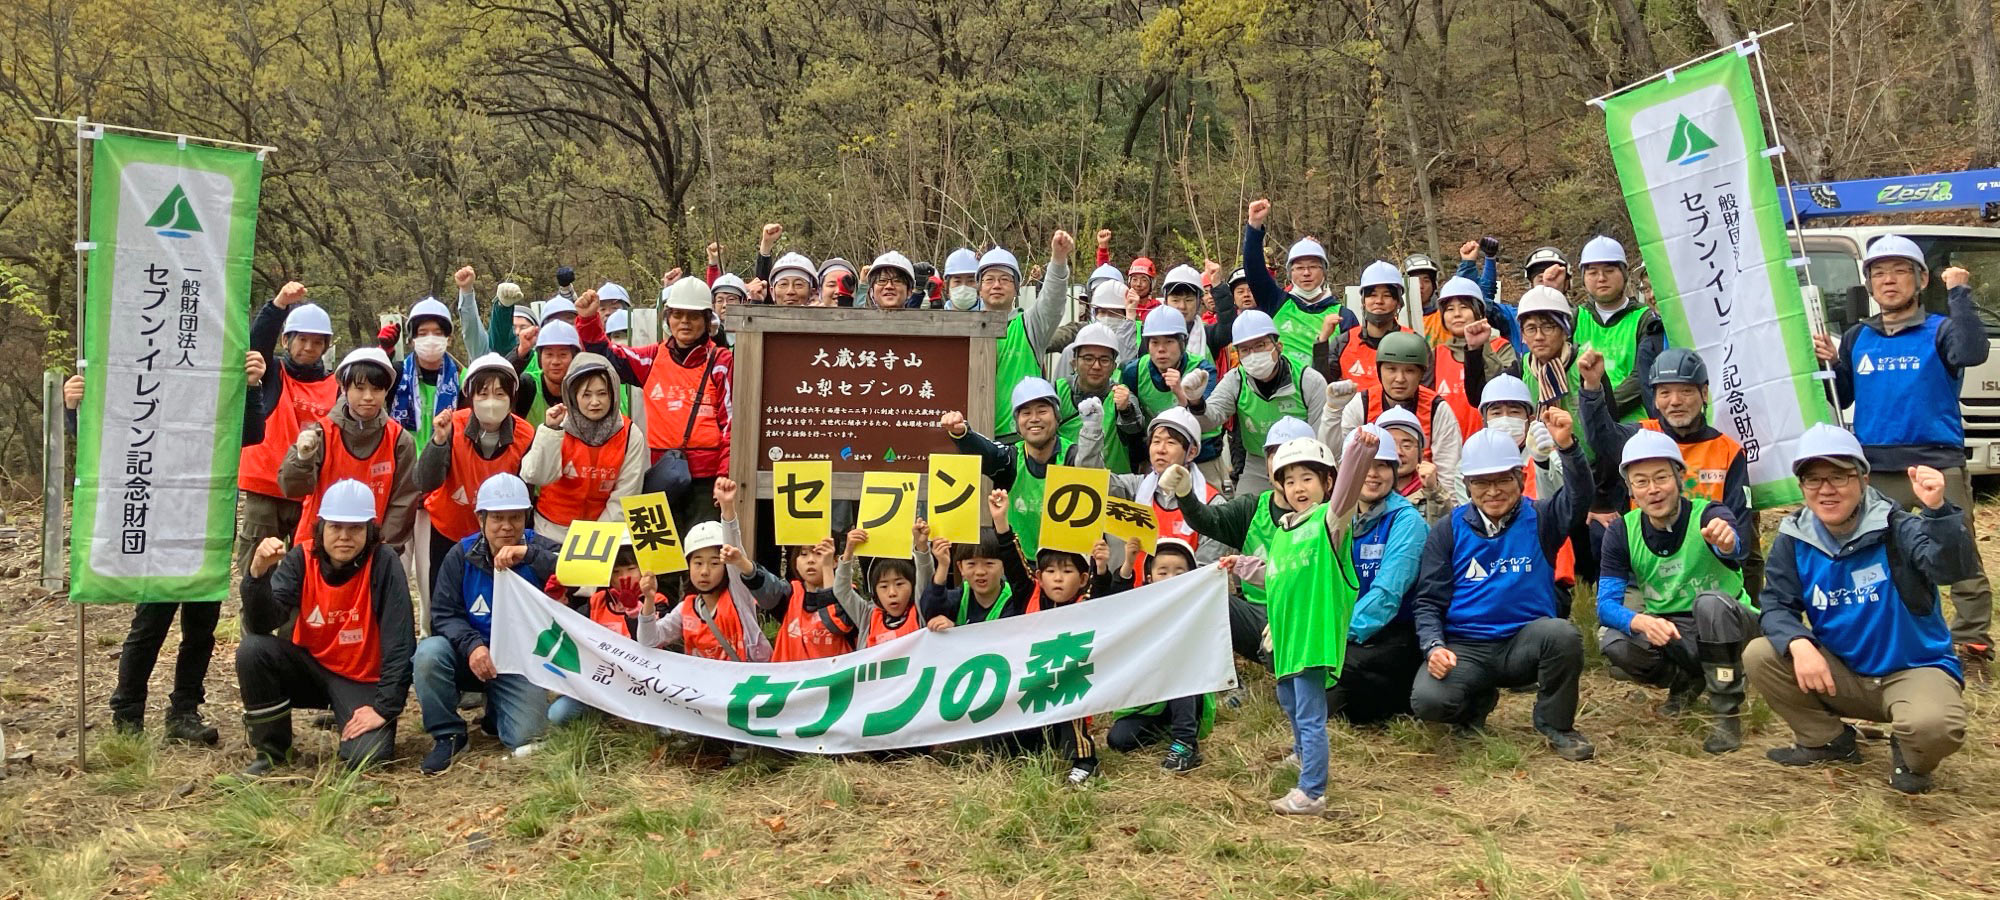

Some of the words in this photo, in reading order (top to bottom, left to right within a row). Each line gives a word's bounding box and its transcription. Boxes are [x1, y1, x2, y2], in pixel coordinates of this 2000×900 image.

[1877, 182, 1940, 203] Zest
[1713, 181, 1742, 278] 一般財団
[175, 267, 203, 368] 一般財団法人
[1680, 192, 1760, 464] セブン-イレン記念財団
[810, 347, 923, 371] 大蔵経寺山
[121, 263, 169, 554] セブン-イレブン記念財団
[795, 378, 936, 399] 山梨セブンの森
[777, 473, 824, 519] セ
[863, 482, 915, 529] ブ
[934, 469, 976, 514] ン
[1047, 484, 1102, 527] の
[629, 504, 675, 551] 梨
[1105, 501, 1155, 529] 森
[564, 531, 616, 563] 山
[588, 637, 662, 673] 一般財団法人
[726, 630, 1095, 738] セブンの森
